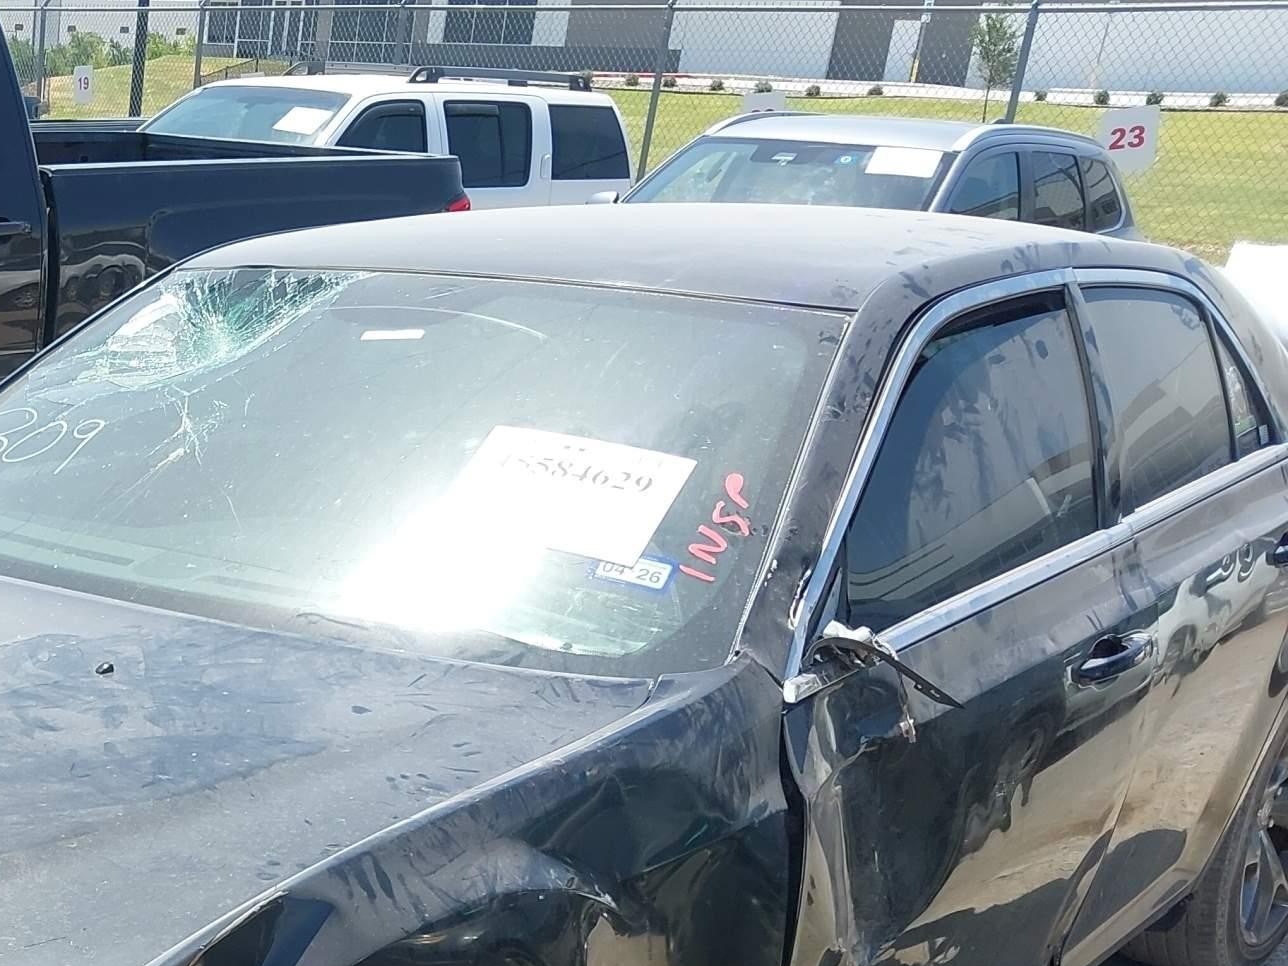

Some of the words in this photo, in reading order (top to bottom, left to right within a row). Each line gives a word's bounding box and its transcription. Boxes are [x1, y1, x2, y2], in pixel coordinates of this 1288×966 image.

[78, 76, 90, 91] 19
[1108, 125, 1146, 151] 23
[635, 567, 663, 584] 26
